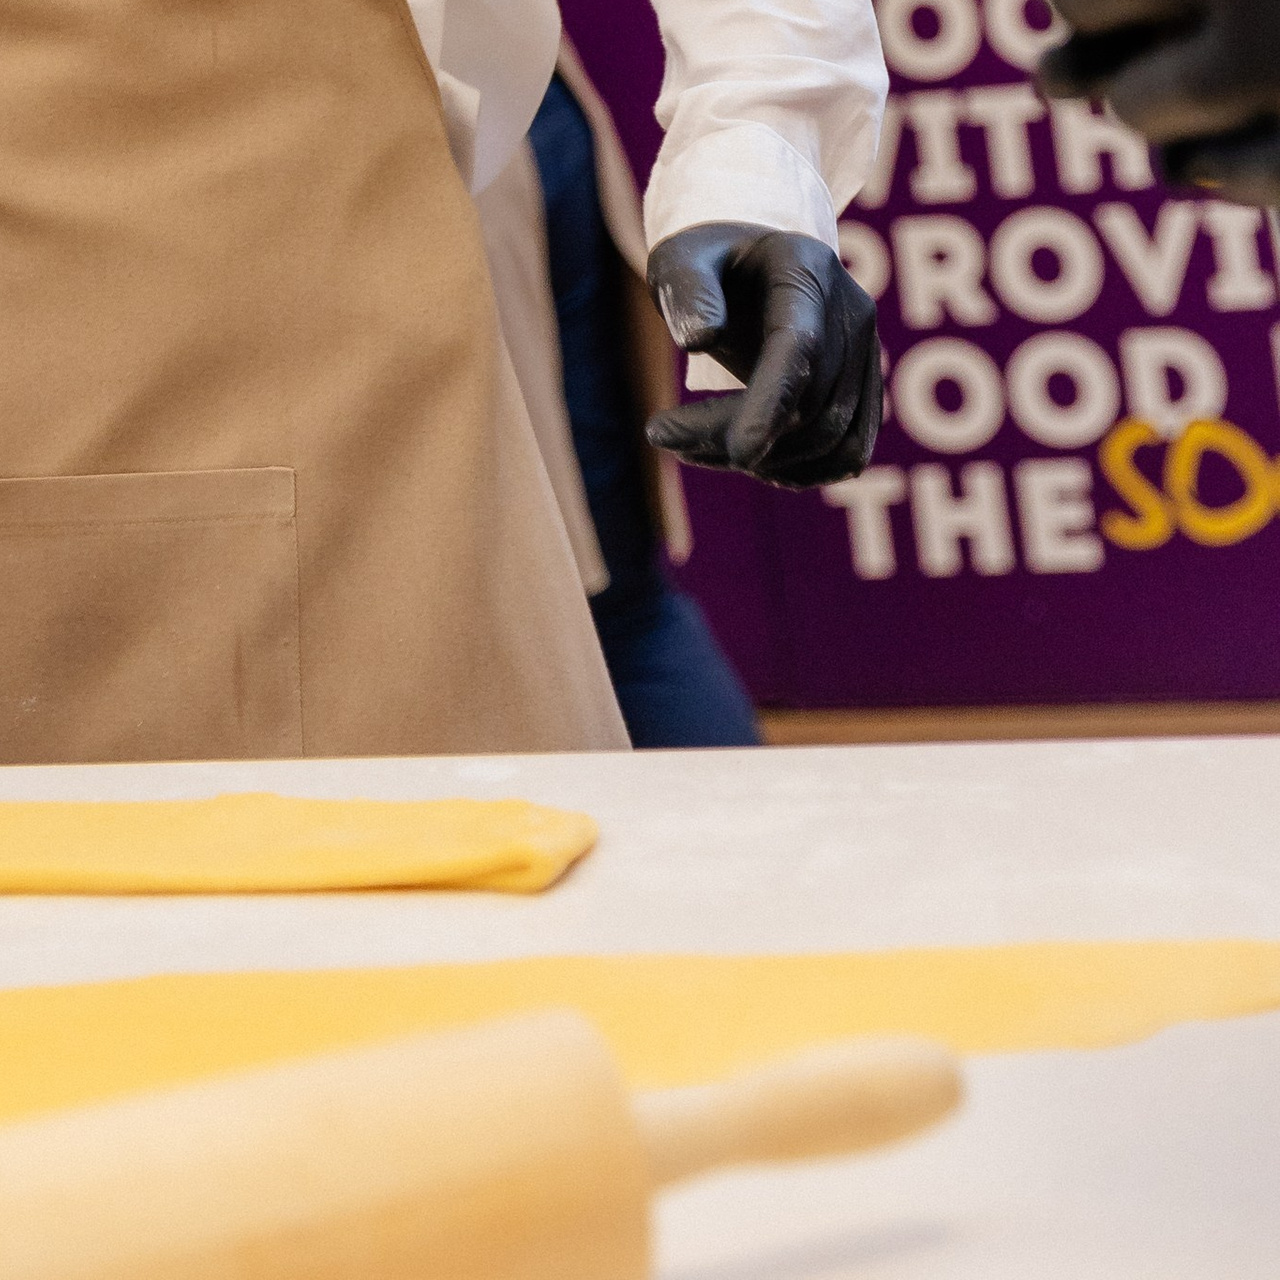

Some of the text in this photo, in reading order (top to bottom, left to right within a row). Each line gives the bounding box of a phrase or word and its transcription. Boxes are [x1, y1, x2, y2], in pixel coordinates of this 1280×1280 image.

[837, 199, 1280, 331] ROVI
[880, 325, 1228, 454] OOD
[823, 416, 1280, 582] THE SO
